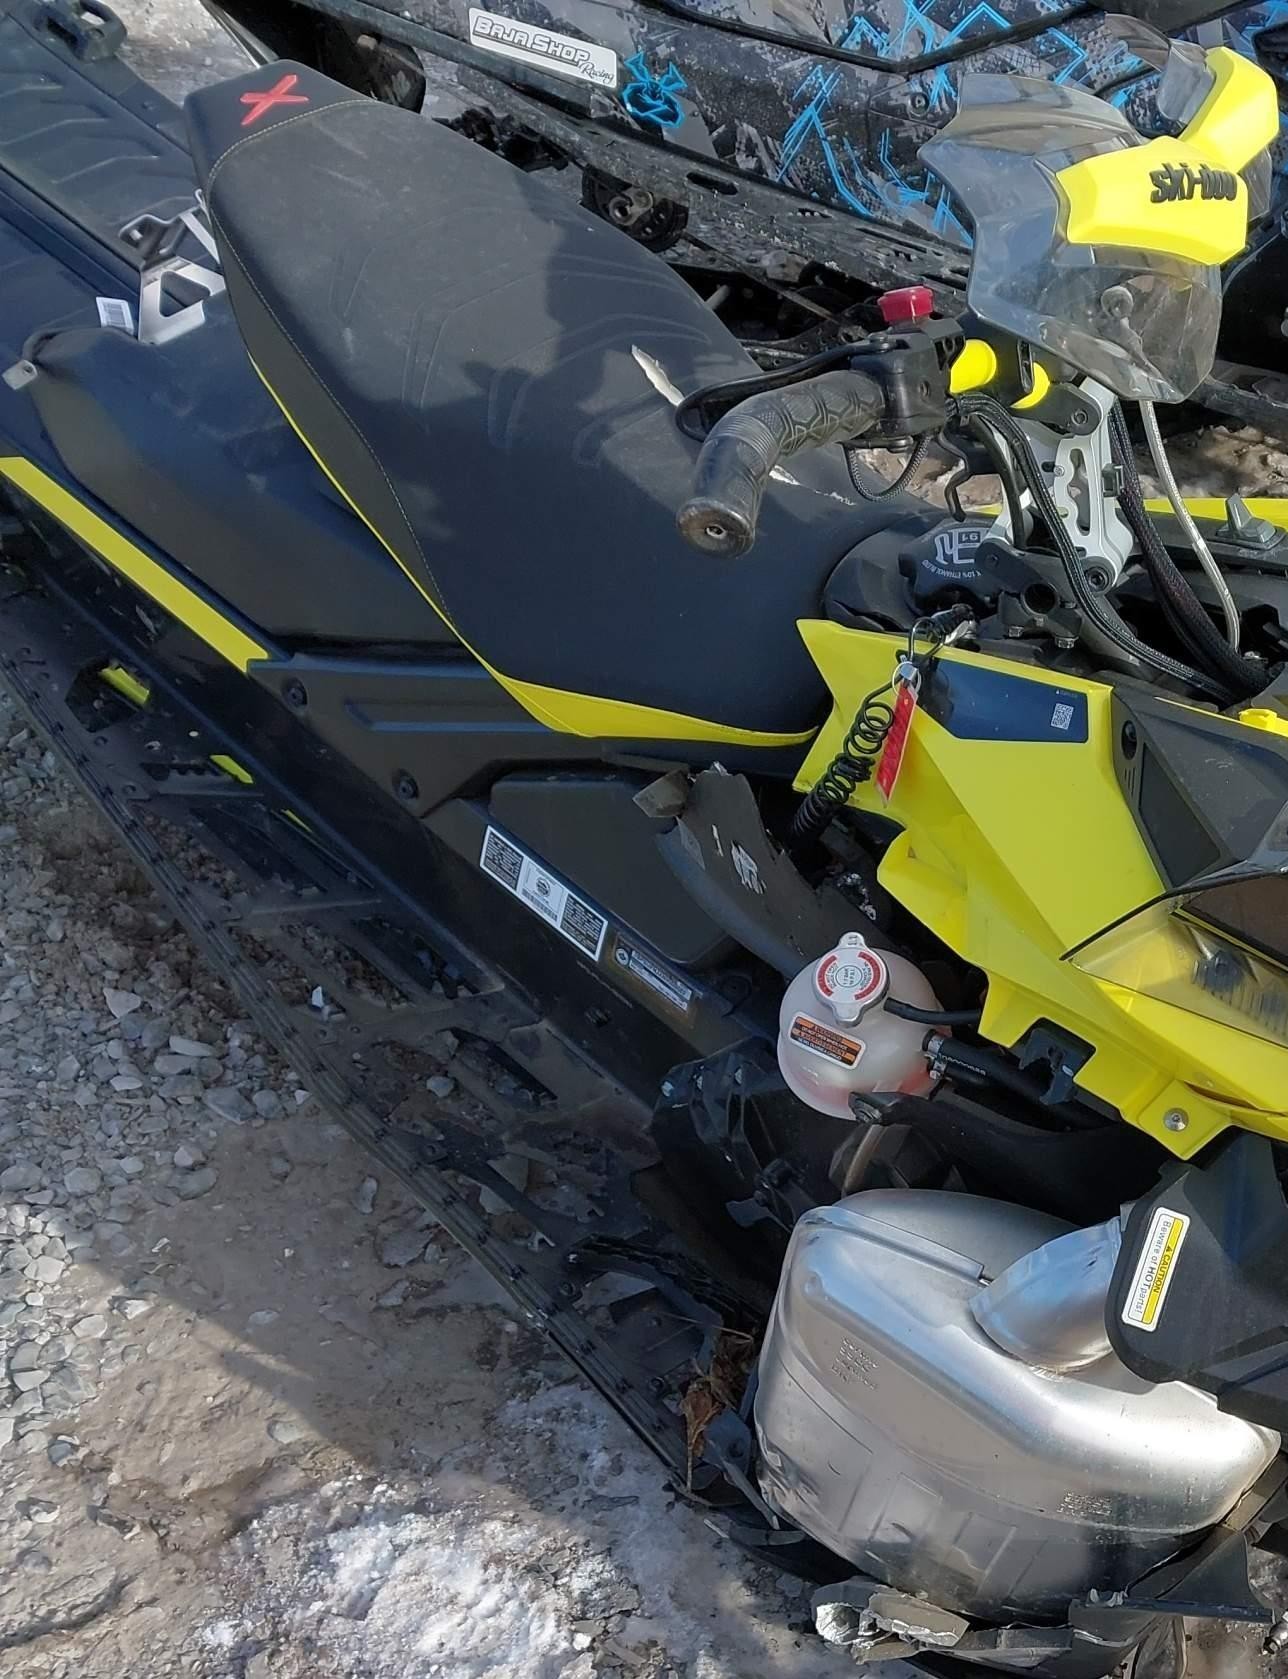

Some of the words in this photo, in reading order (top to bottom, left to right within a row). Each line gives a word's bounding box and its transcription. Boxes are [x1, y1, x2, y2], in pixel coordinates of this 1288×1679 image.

[530, 33, 590, 65] SHOP
[578, 61, 614, 85] Racing
[961, 532, 978, 542] 91
[1154, 1220, 1172, 1255] Beware
[1144, 1266, 1157, 1290] HOT
[1153, 1253, 1172, 1294] CAUTION
